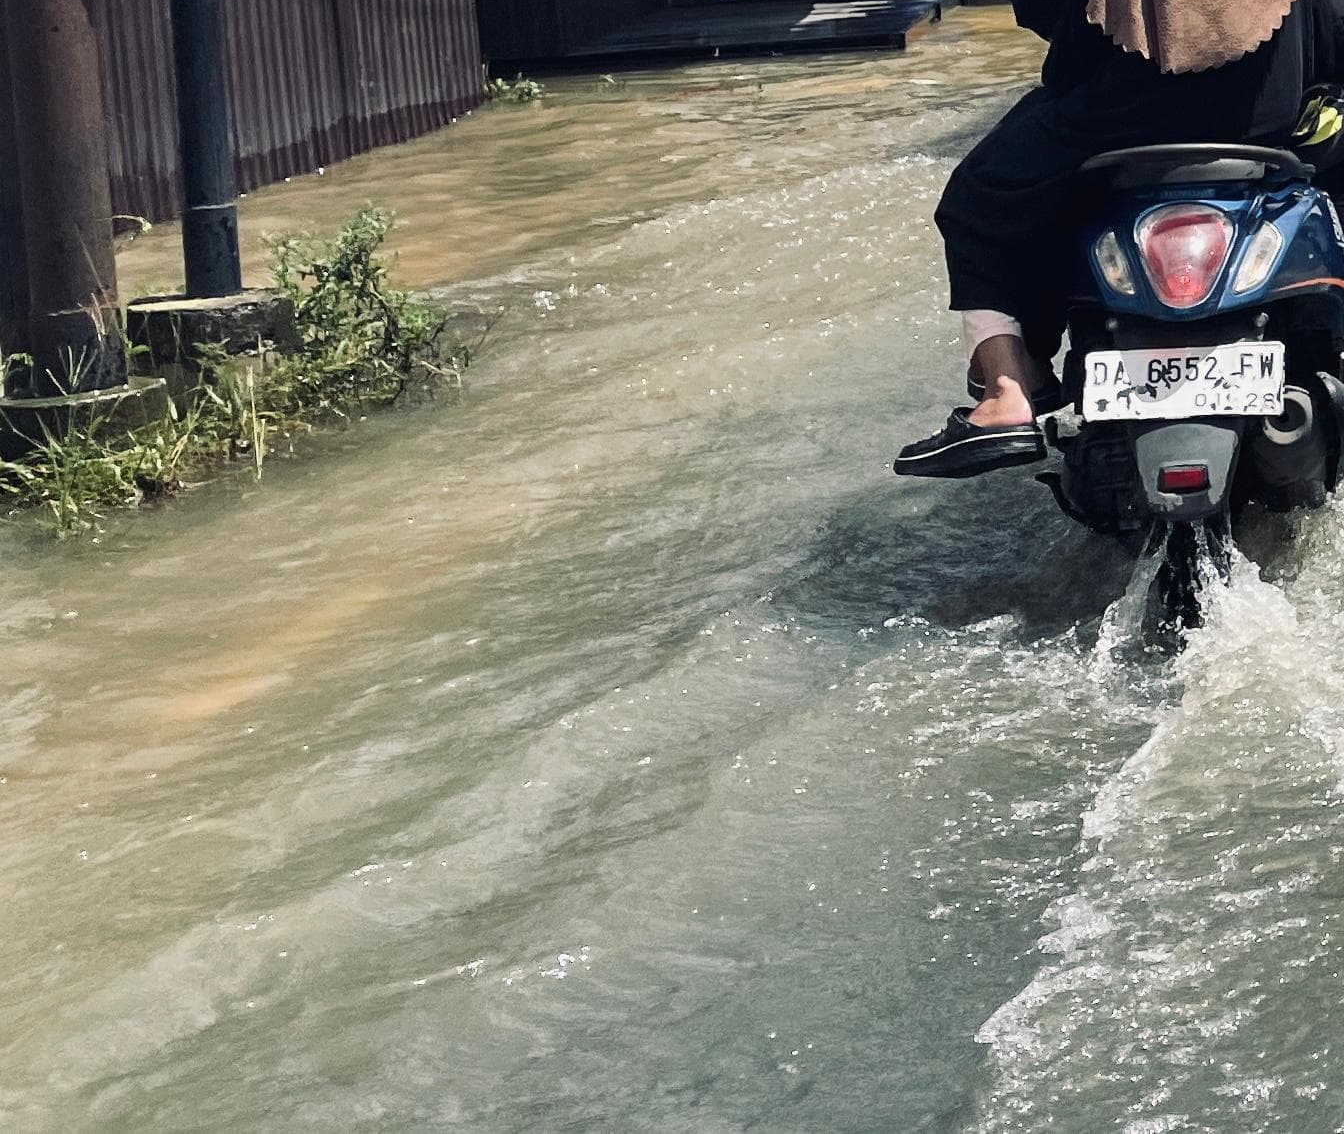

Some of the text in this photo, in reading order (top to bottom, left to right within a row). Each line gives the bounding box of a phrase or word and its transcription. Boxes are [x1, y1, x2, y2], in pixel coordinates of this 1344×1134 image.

[1093, 352, 1274, 387] DA 6552 FW
